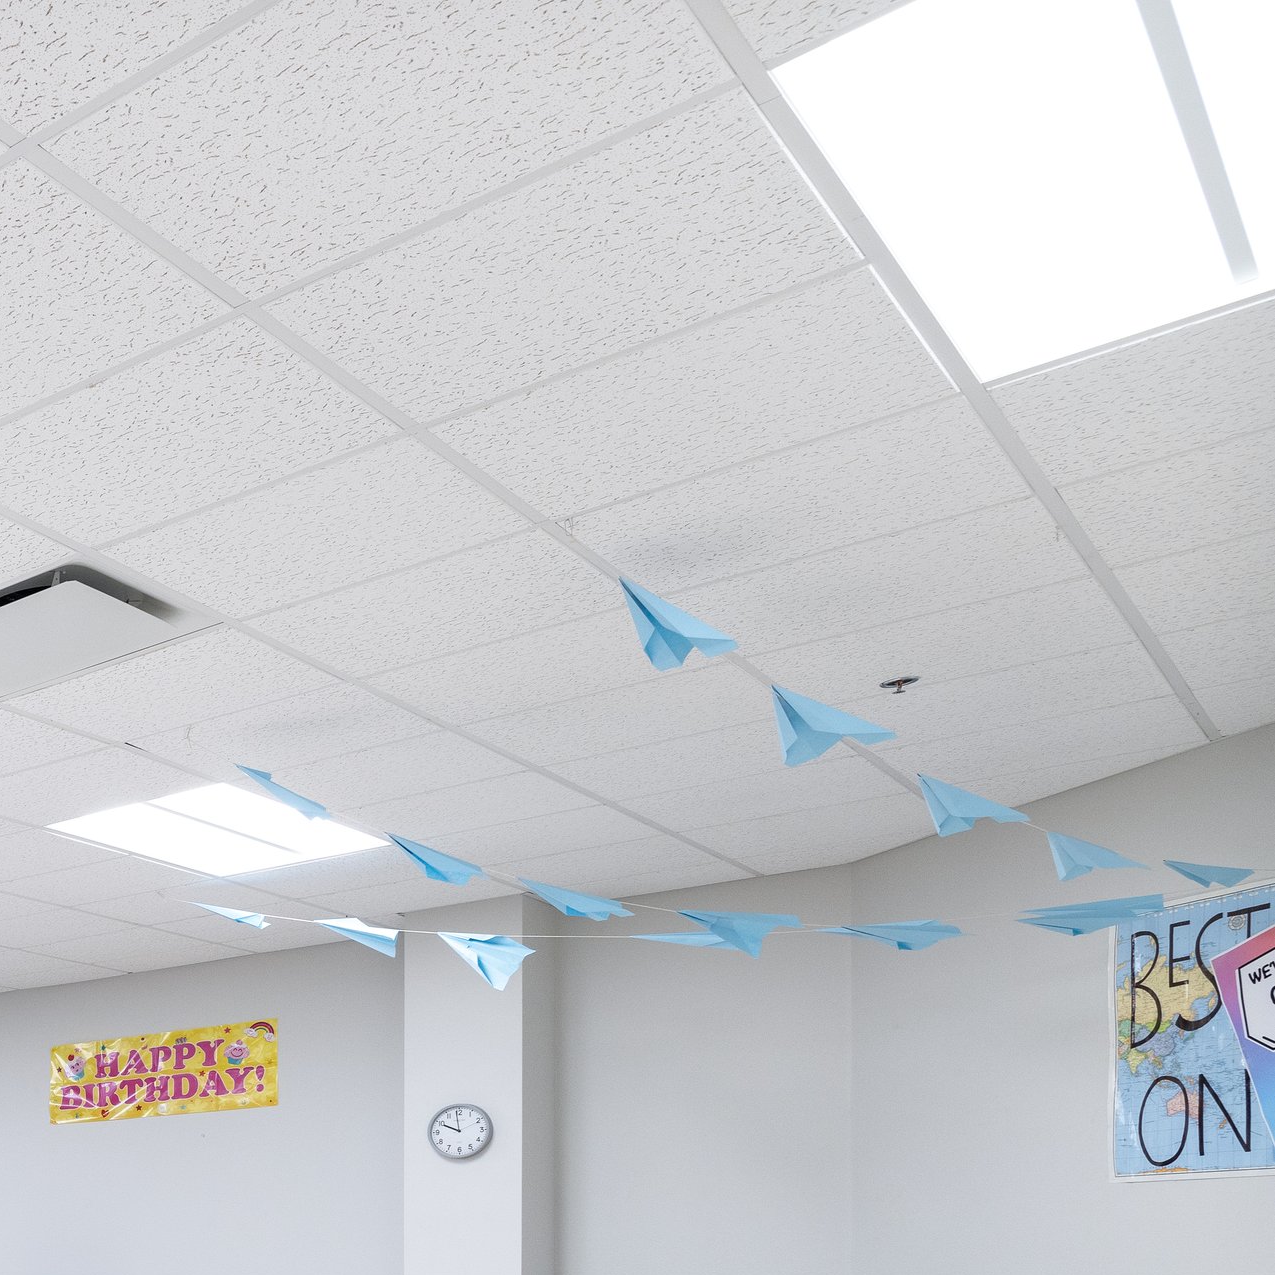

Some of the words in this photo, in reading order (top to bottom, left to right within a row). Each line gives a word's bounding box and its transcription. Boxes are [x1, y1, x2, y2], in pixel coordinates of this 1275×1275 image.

[1130, 902, 1271, 1049] BEST
[59, 1066, 265, 1110] BIRTHDAY!
[95, 1039, 225, 1079] HAPPY
[1138, 1069, 1251, 1167] ON
